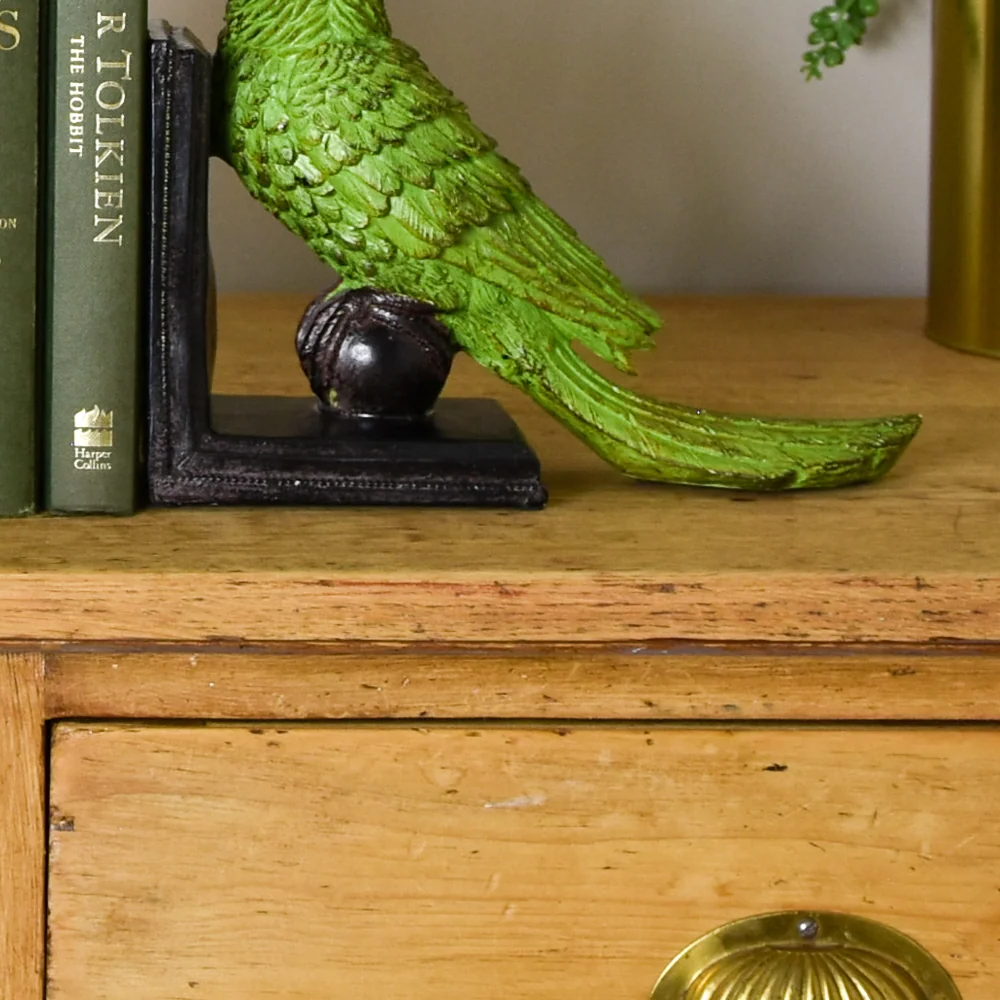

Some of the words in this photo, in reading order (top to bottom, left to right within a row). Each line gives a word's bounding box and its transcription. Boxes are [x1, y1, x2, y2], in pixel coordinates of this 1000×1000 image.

[70, 35, 85, 74] THE
[68, 81, 85, 157] HOBBIT
[93, 49, 132, 246] TOLKIEN
[74, 448, 112, 461] Harper
[74, 459, 112, 471] Collins
